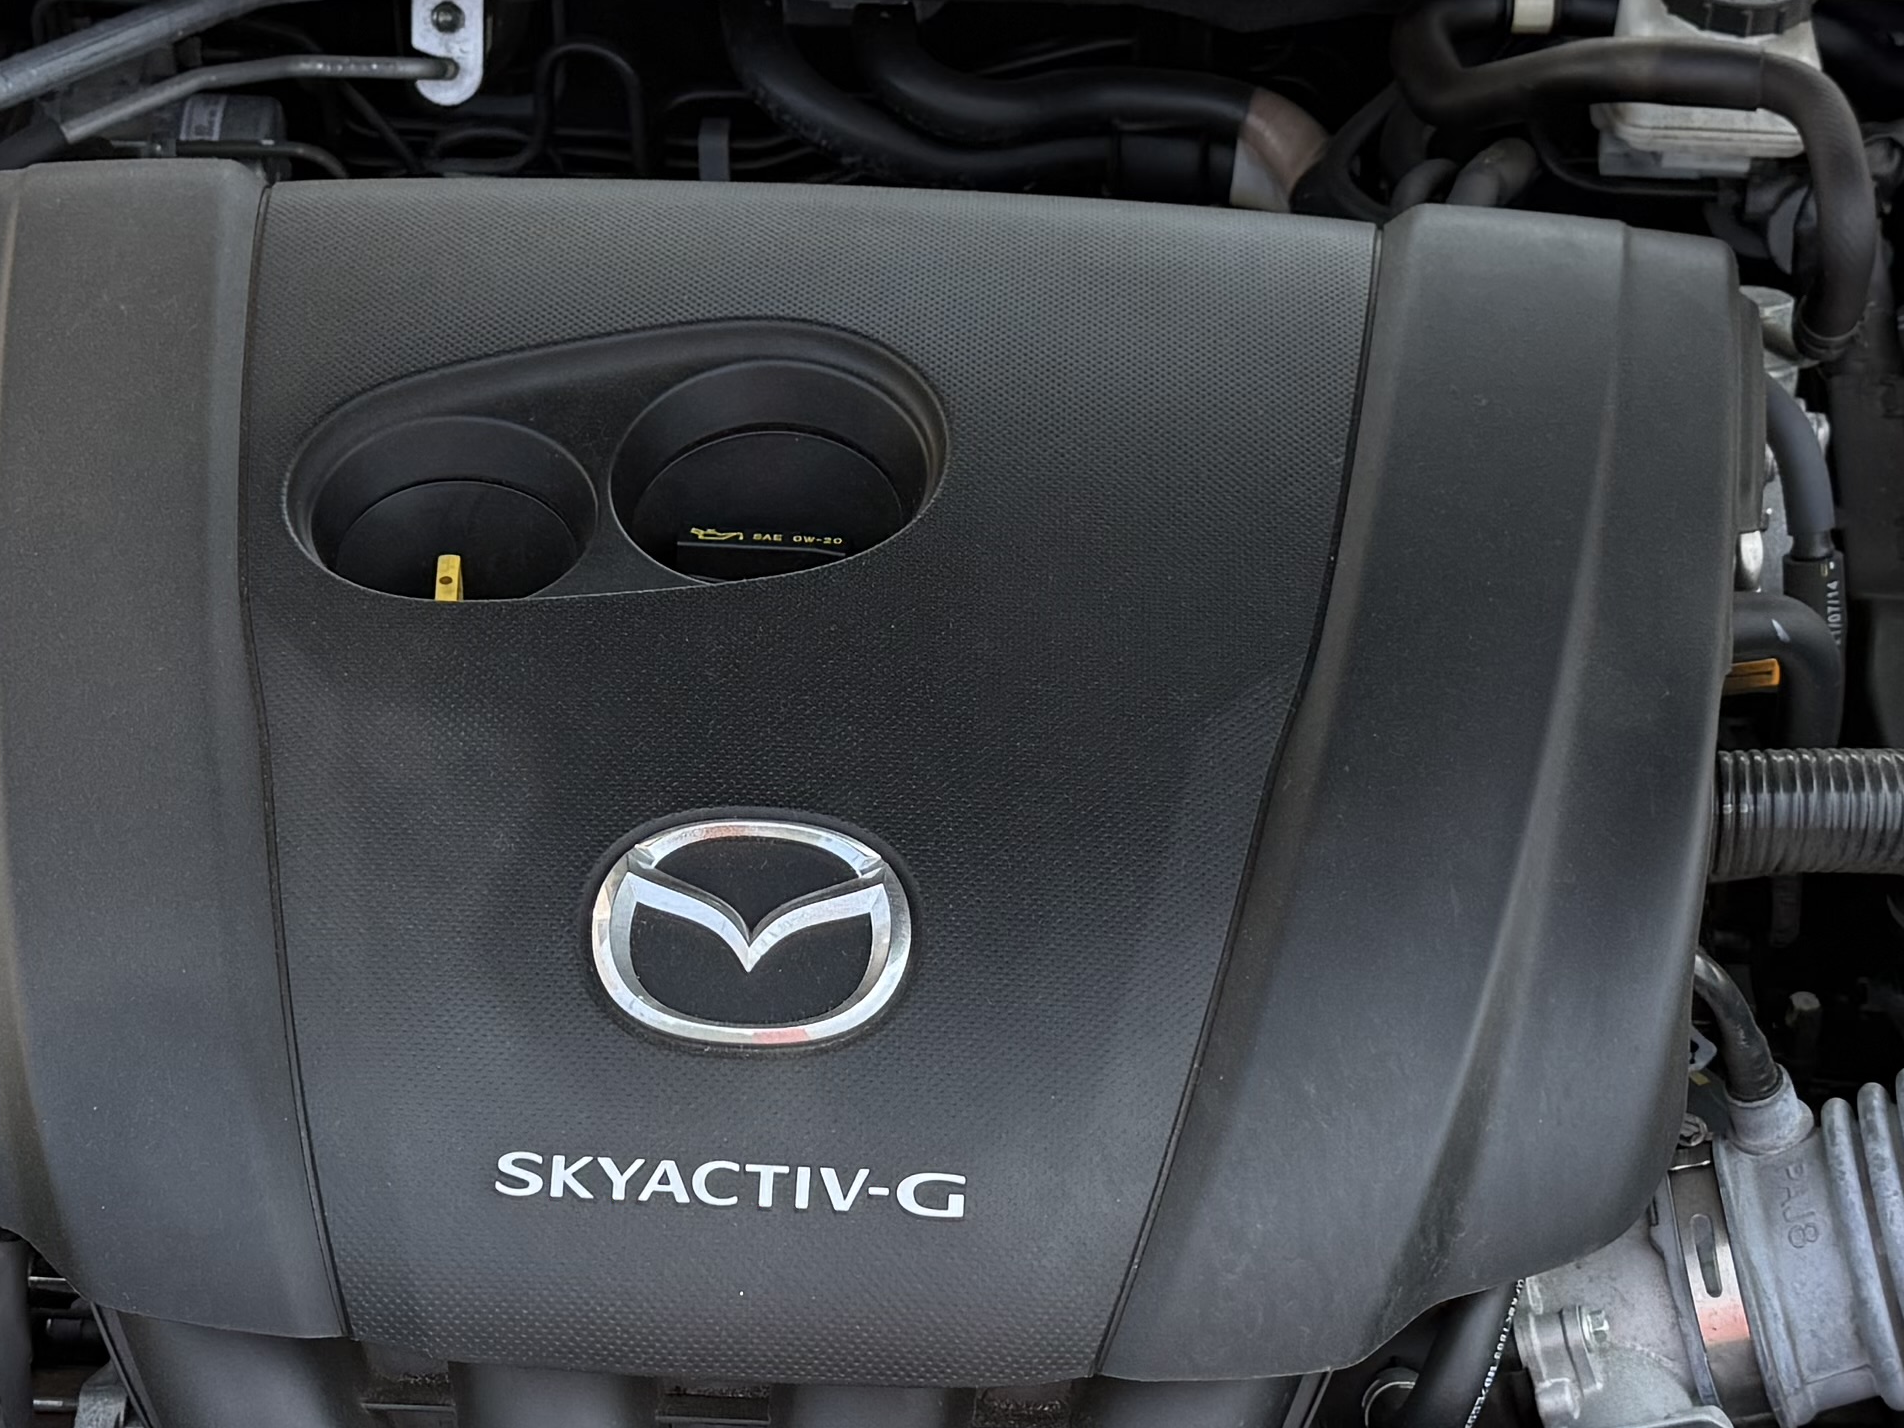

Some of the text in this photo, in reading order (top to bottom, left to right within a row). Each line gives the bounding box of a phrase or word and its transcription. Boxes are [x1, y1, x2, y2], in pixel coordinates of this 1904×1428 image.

[752, 533, 843, 545] SAE 0W-20
[494, 1150, 968, 1218] SKYACTIV-G
